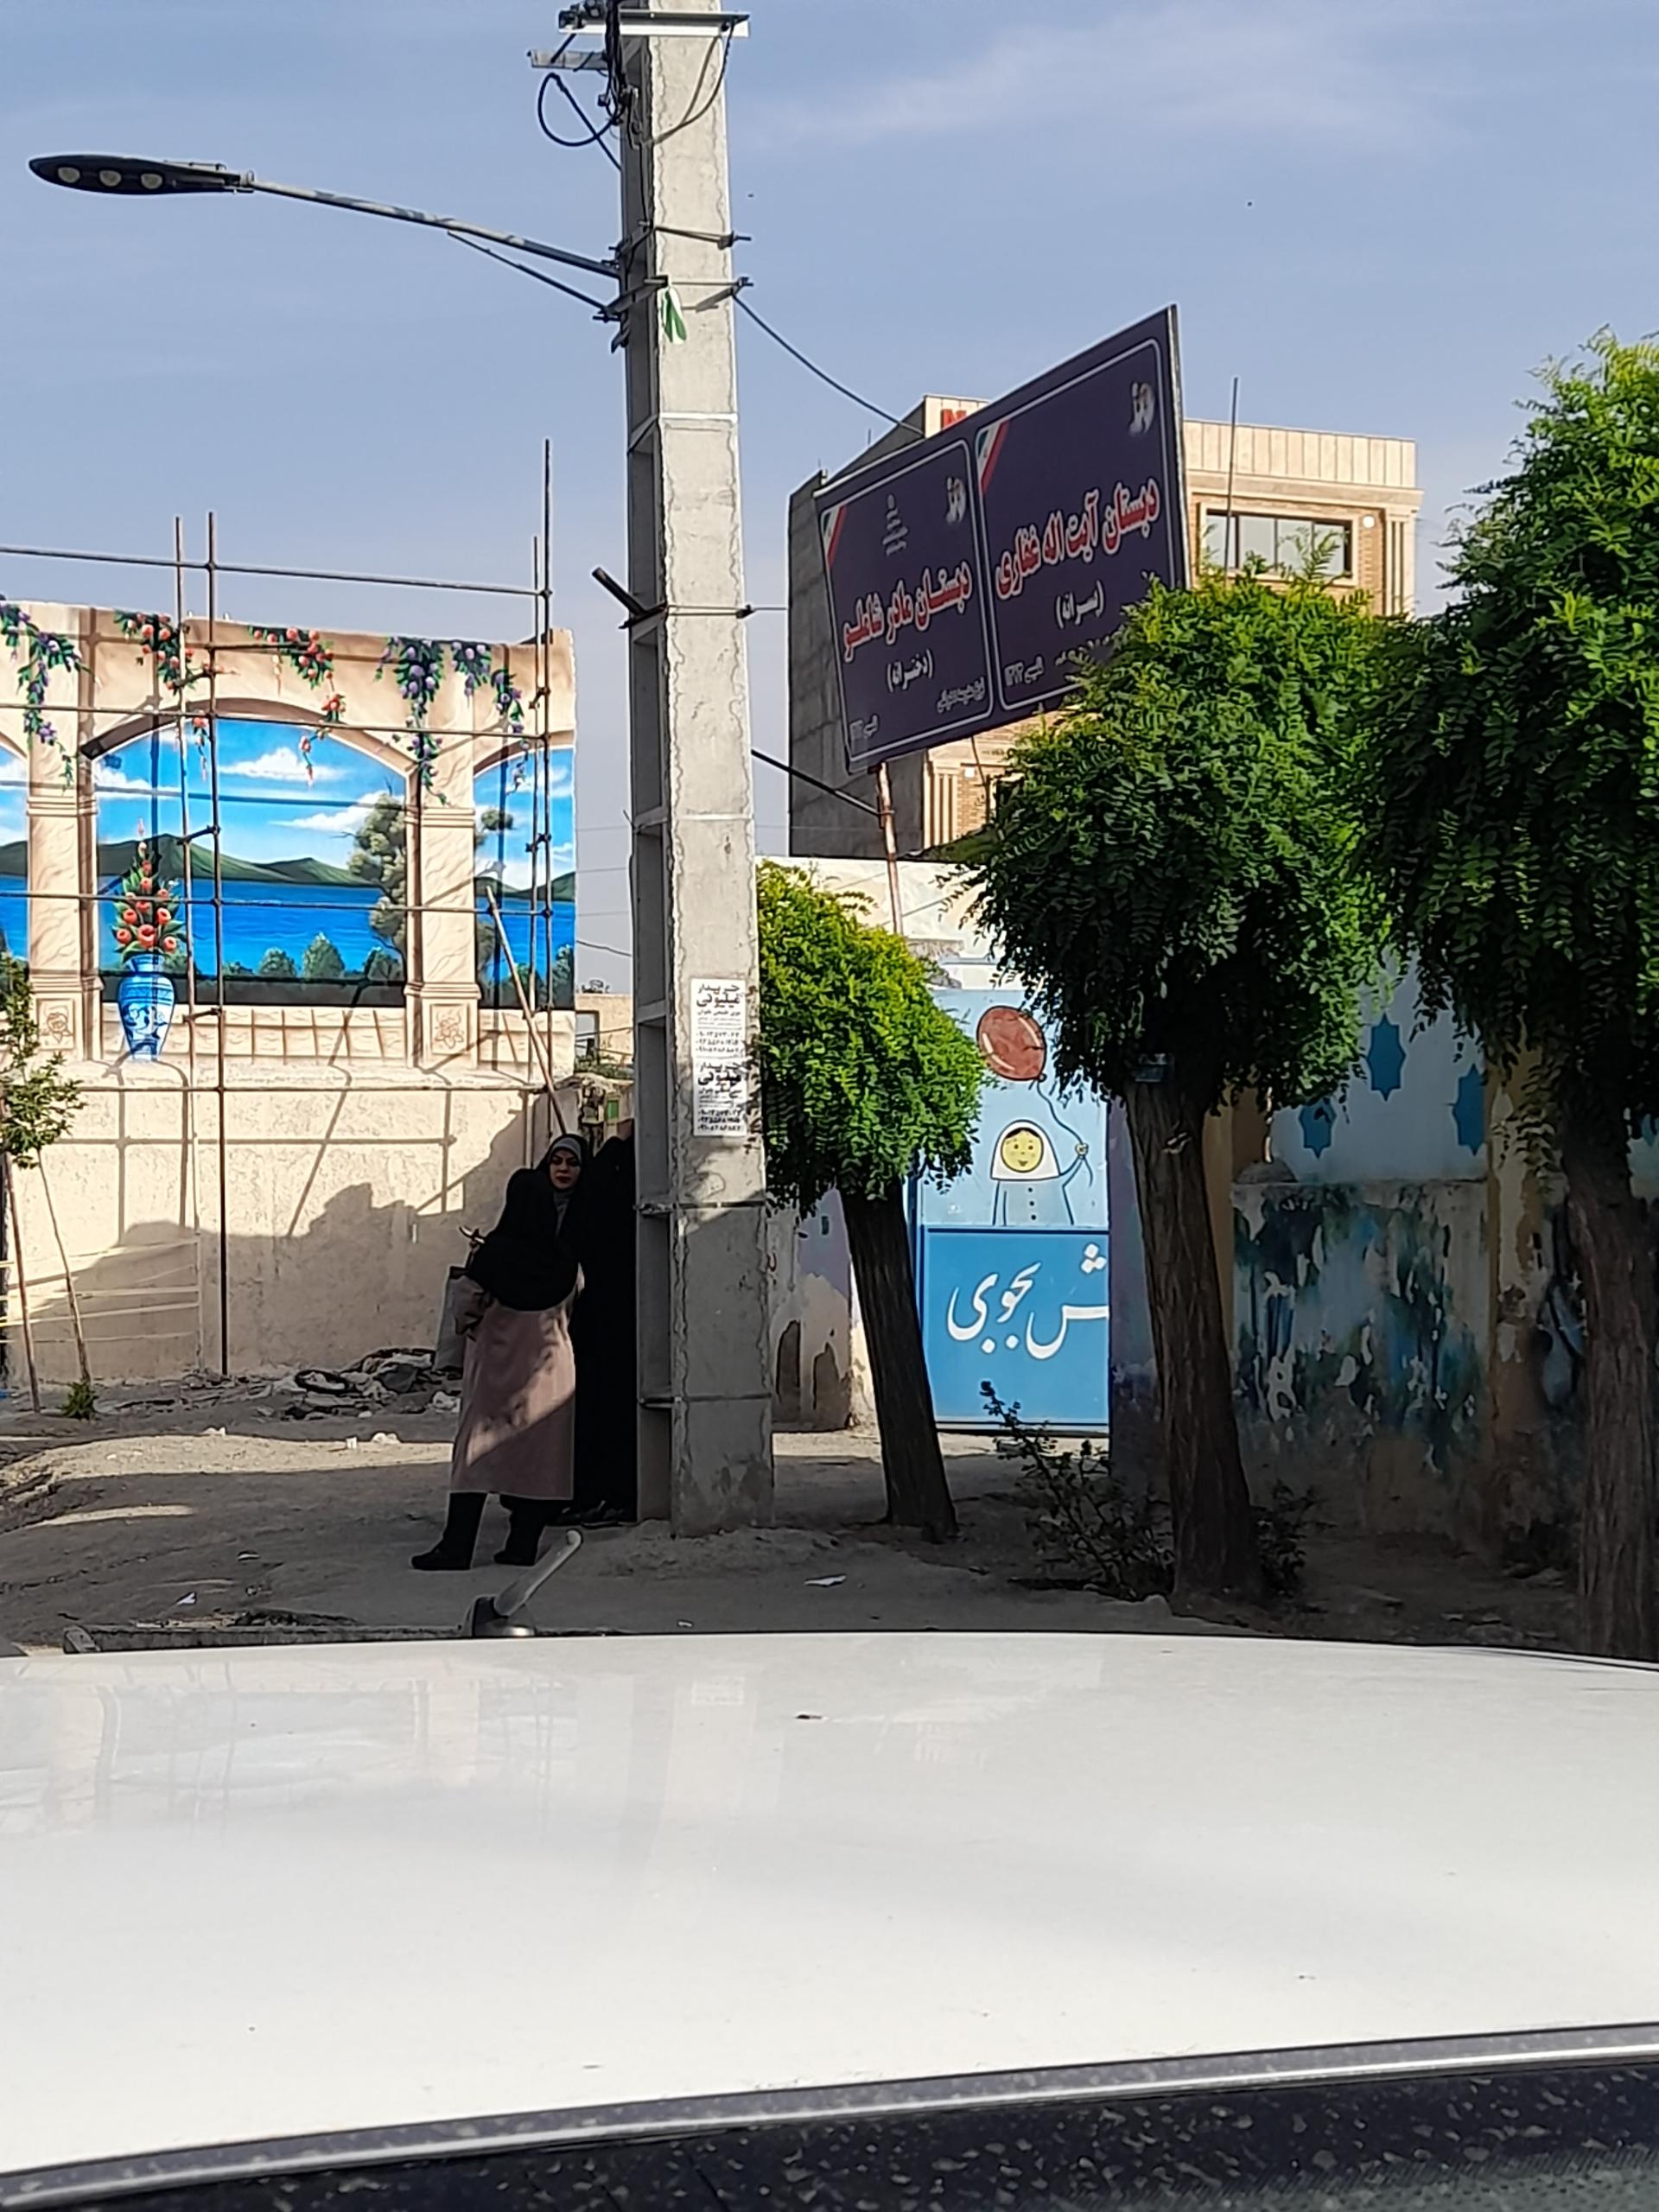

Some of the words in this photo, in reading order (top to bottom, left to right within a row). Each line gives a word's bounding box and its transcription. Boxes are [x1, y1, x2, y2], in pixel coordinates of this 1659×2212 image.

[1043, 510, 1065, 565] اله
[1065, 488, 1099, 563] آیت
[1103, 477, 1160, 554] دبستان
[915, 561, 972, 631] دبستان
[996, 524, 1041, 600] غفاری
[887, 580, 913, 645] مادر
